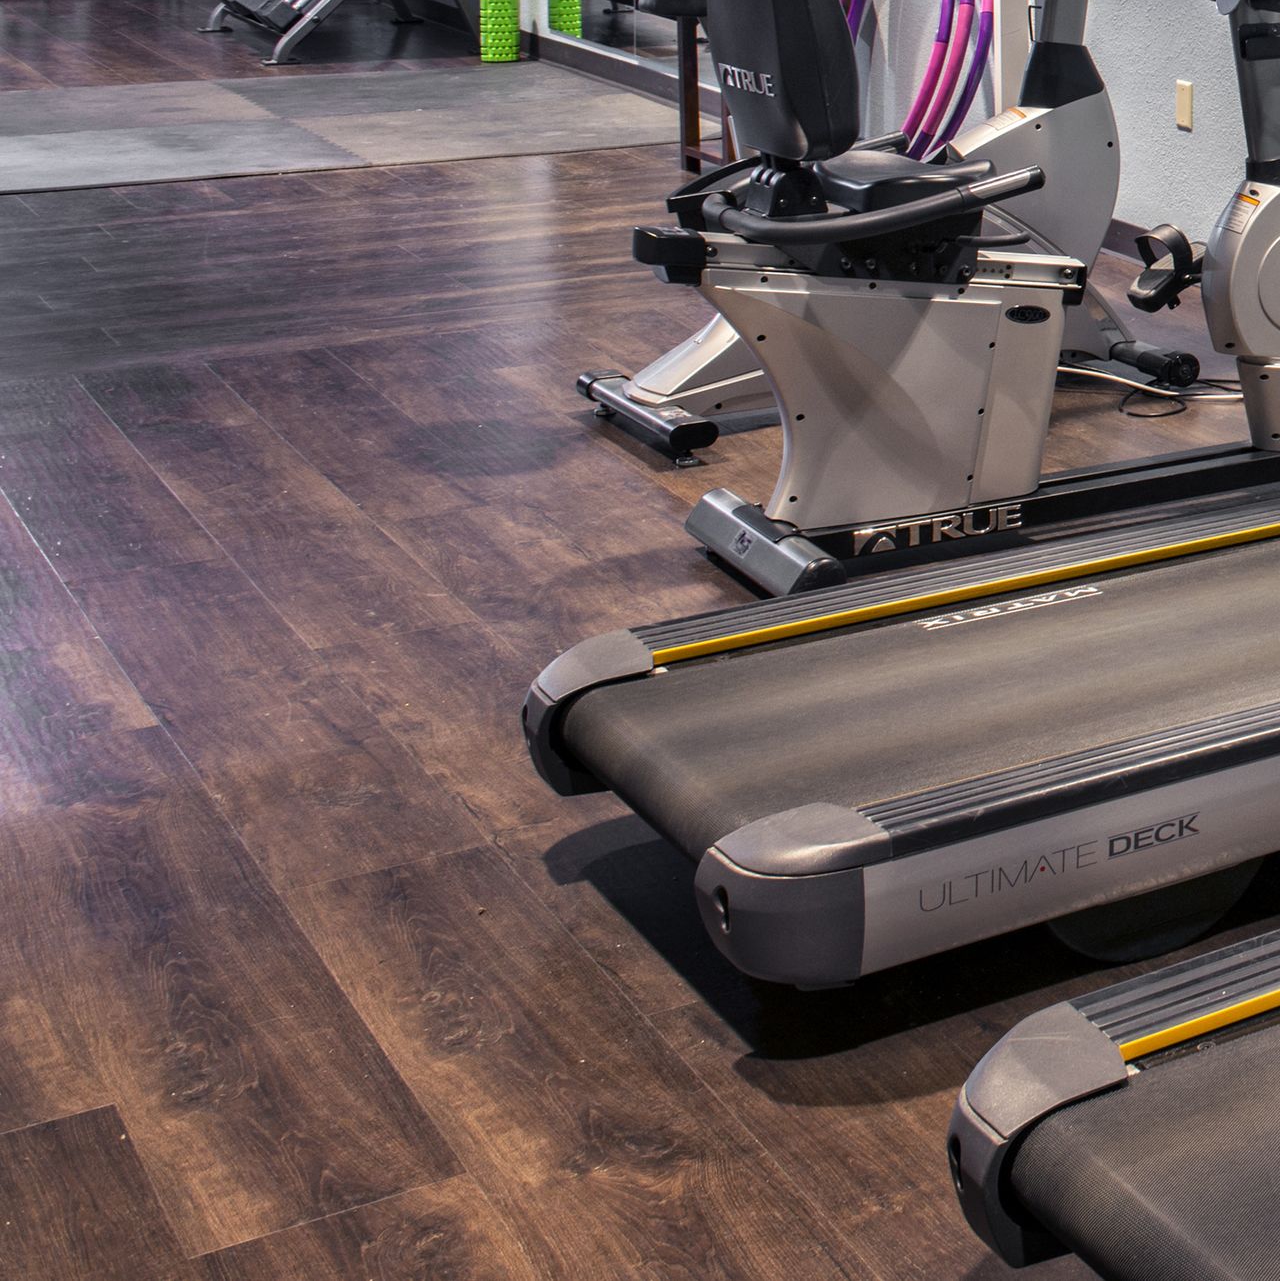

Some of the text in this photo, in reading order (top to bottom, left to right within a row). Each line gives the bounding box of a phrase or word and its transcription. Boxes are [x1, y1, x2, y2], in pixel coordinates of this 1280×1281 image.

[731, 66, 775, 97] TRUE
[898, 504, 1023, 548] TRUE
[919, 585, 1099, 629] MATRIX
[919, 813, 1200, 913] ULTIMATE DECK
